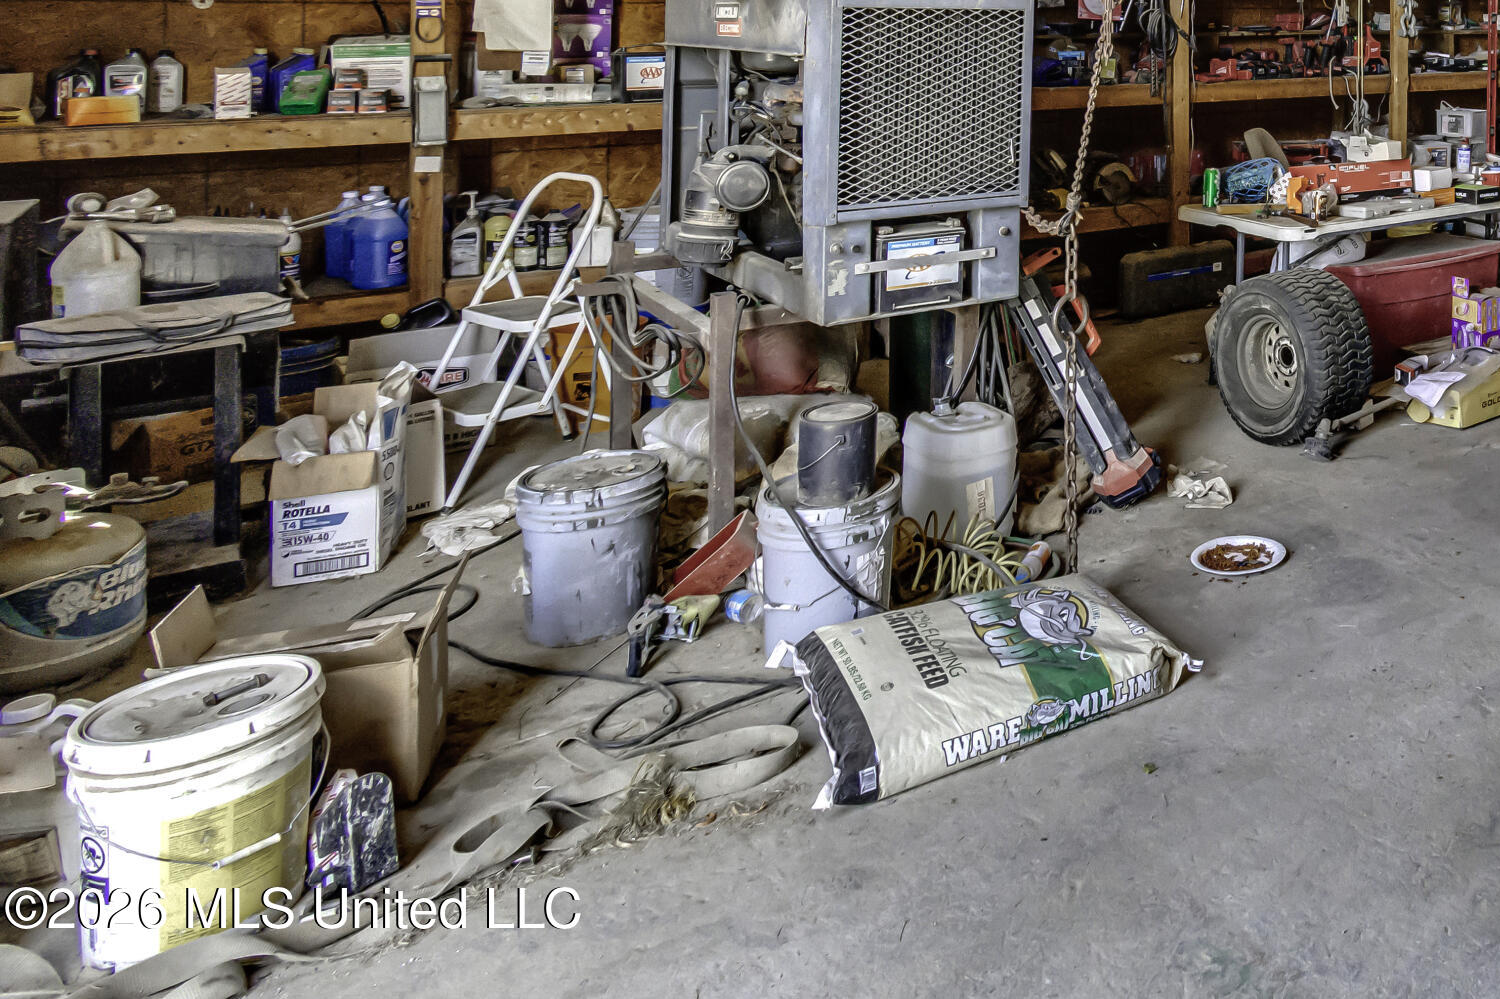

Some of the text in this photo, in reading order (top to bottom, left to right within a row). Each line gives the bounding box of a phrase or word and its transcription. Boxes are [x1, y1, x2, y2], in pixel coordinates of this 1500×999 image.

[283, 500, 306, 509] Shell
[283, 505, 331, 519] ROTELLA
[283, 520, 297, 531] T4
[882, 610, 949, 690] CATFISH FEED
[920, 628, 967, 679] FLOATING
[942, 715, 1023, 767] WARE
